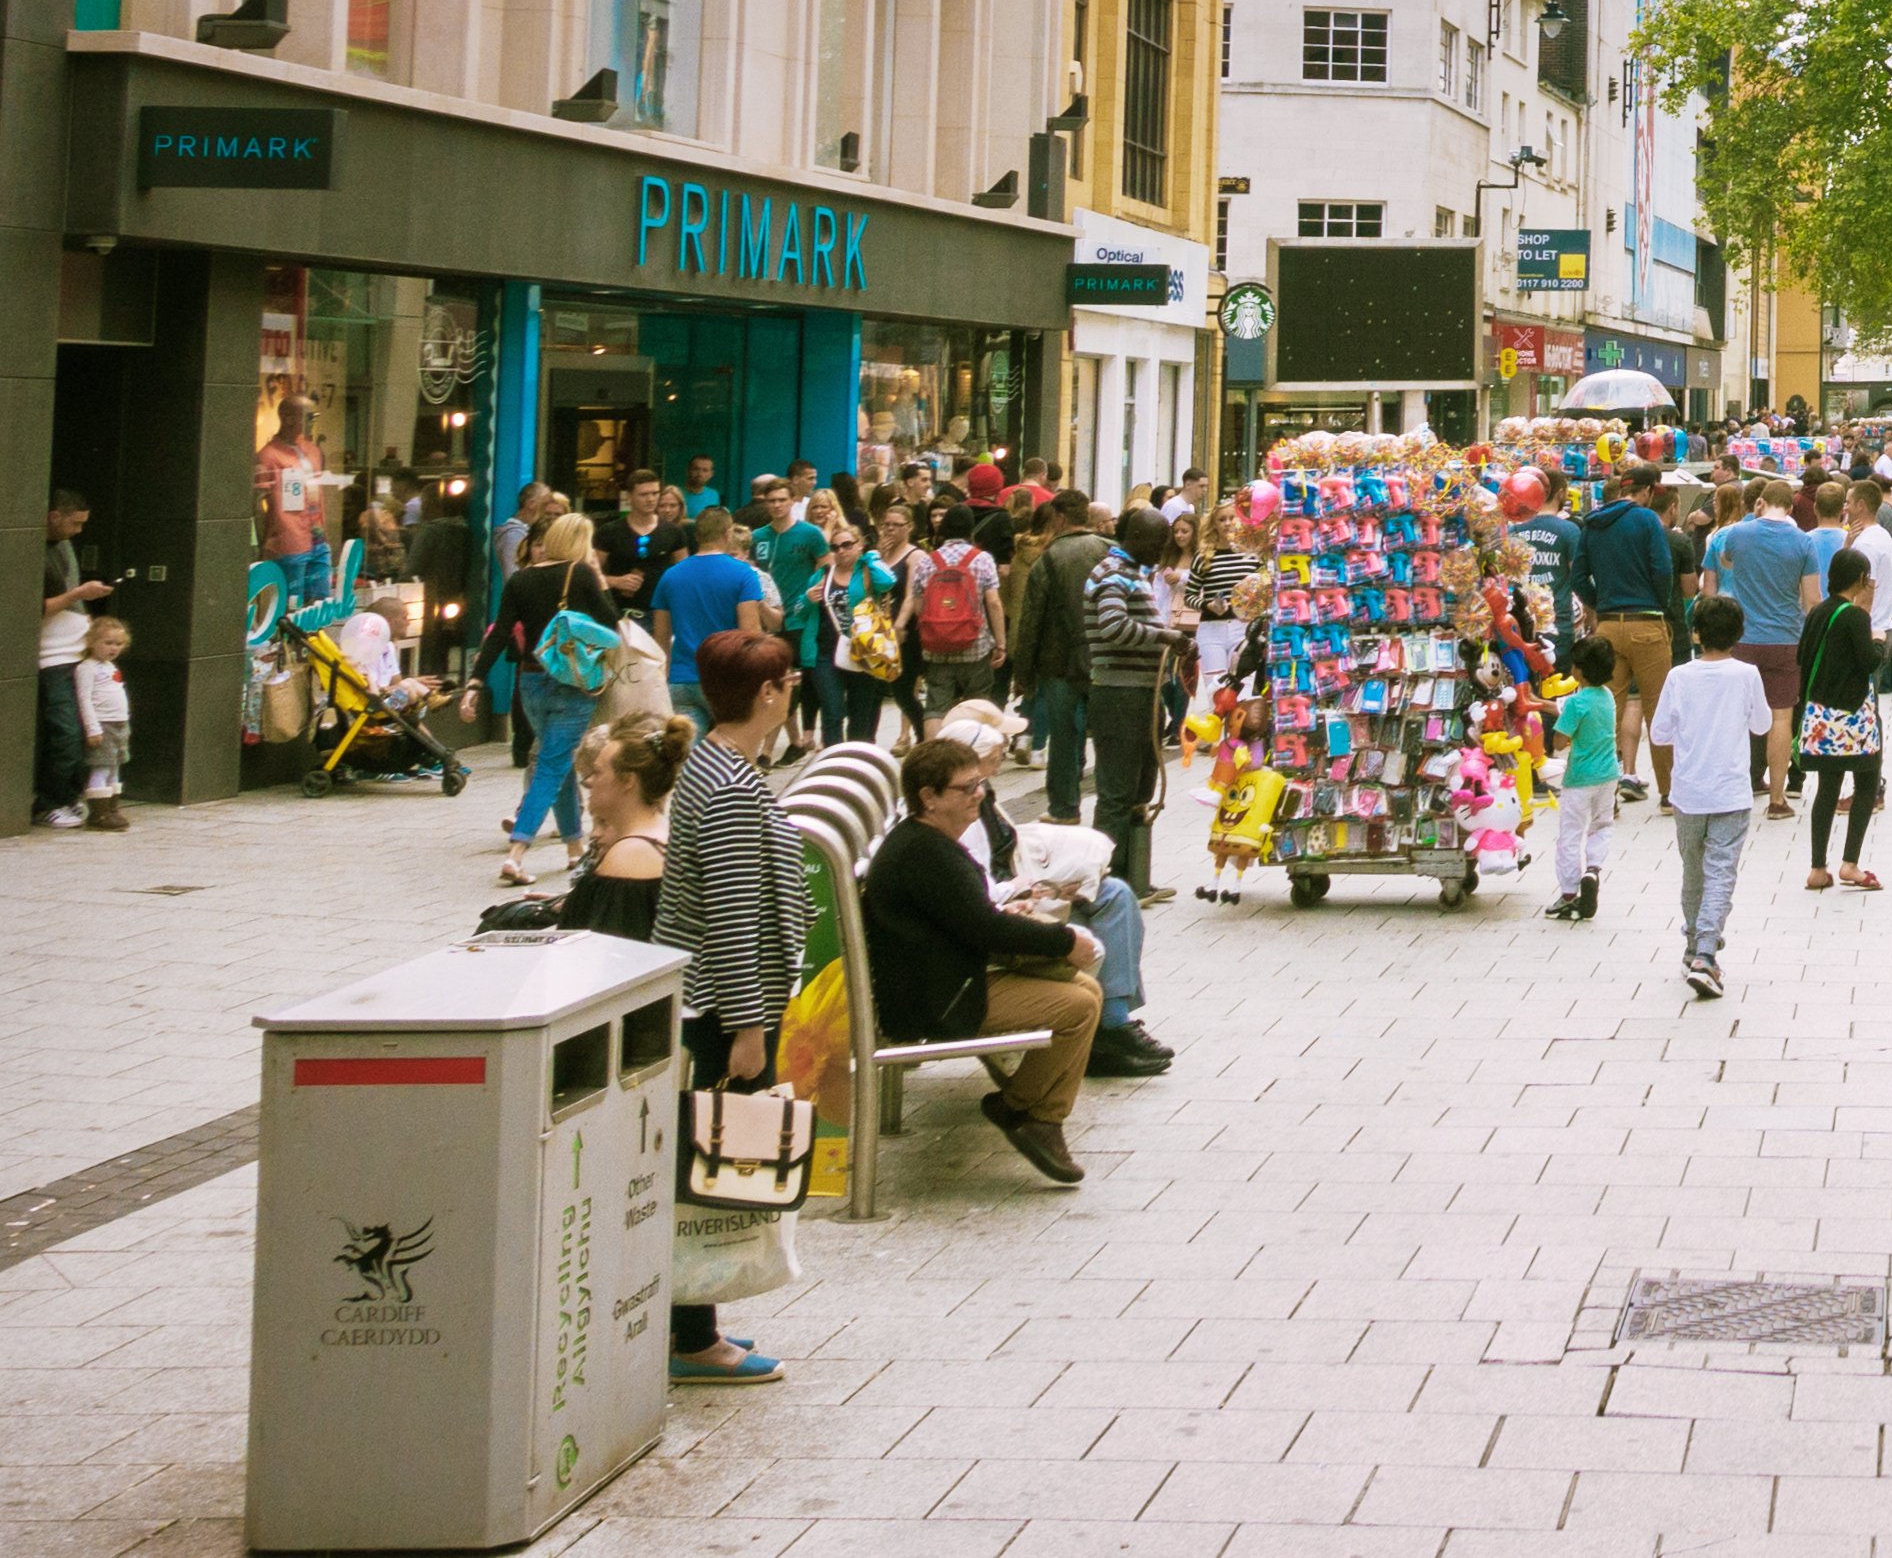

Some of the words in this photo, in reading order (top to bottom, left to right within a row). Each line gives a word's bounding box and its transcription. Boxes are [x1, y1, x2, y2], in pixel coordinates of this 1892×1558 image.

[154, 134, 313, 160] PRIMARK
[637, 175, 870, 292] PRIMARK
[1518, 234, 1549, 245] SHOP
[1096, 247, 1144, 263] Optical
[1518, 250, 1532, 260] TO
[1535, 250, 1557, 260] LET
[1074, 278, 1159, 291] PRIMARK
[1541, 279, 1558, 287] 910
[1561, 279, 1584, 288] 2200
[628, 1172, 656, 1200] Other
[625, 1200, 657, 1231] Waste
[612, 1272, 661, 1321] Gwastraff
[335, 1305, 426, 1324] CARDIFF
[552, 1204, 576, 1412] Recycling
[320, 1328, 442, 1346] CAERDYDD
[625, 1310, 649, 1343] Arall
